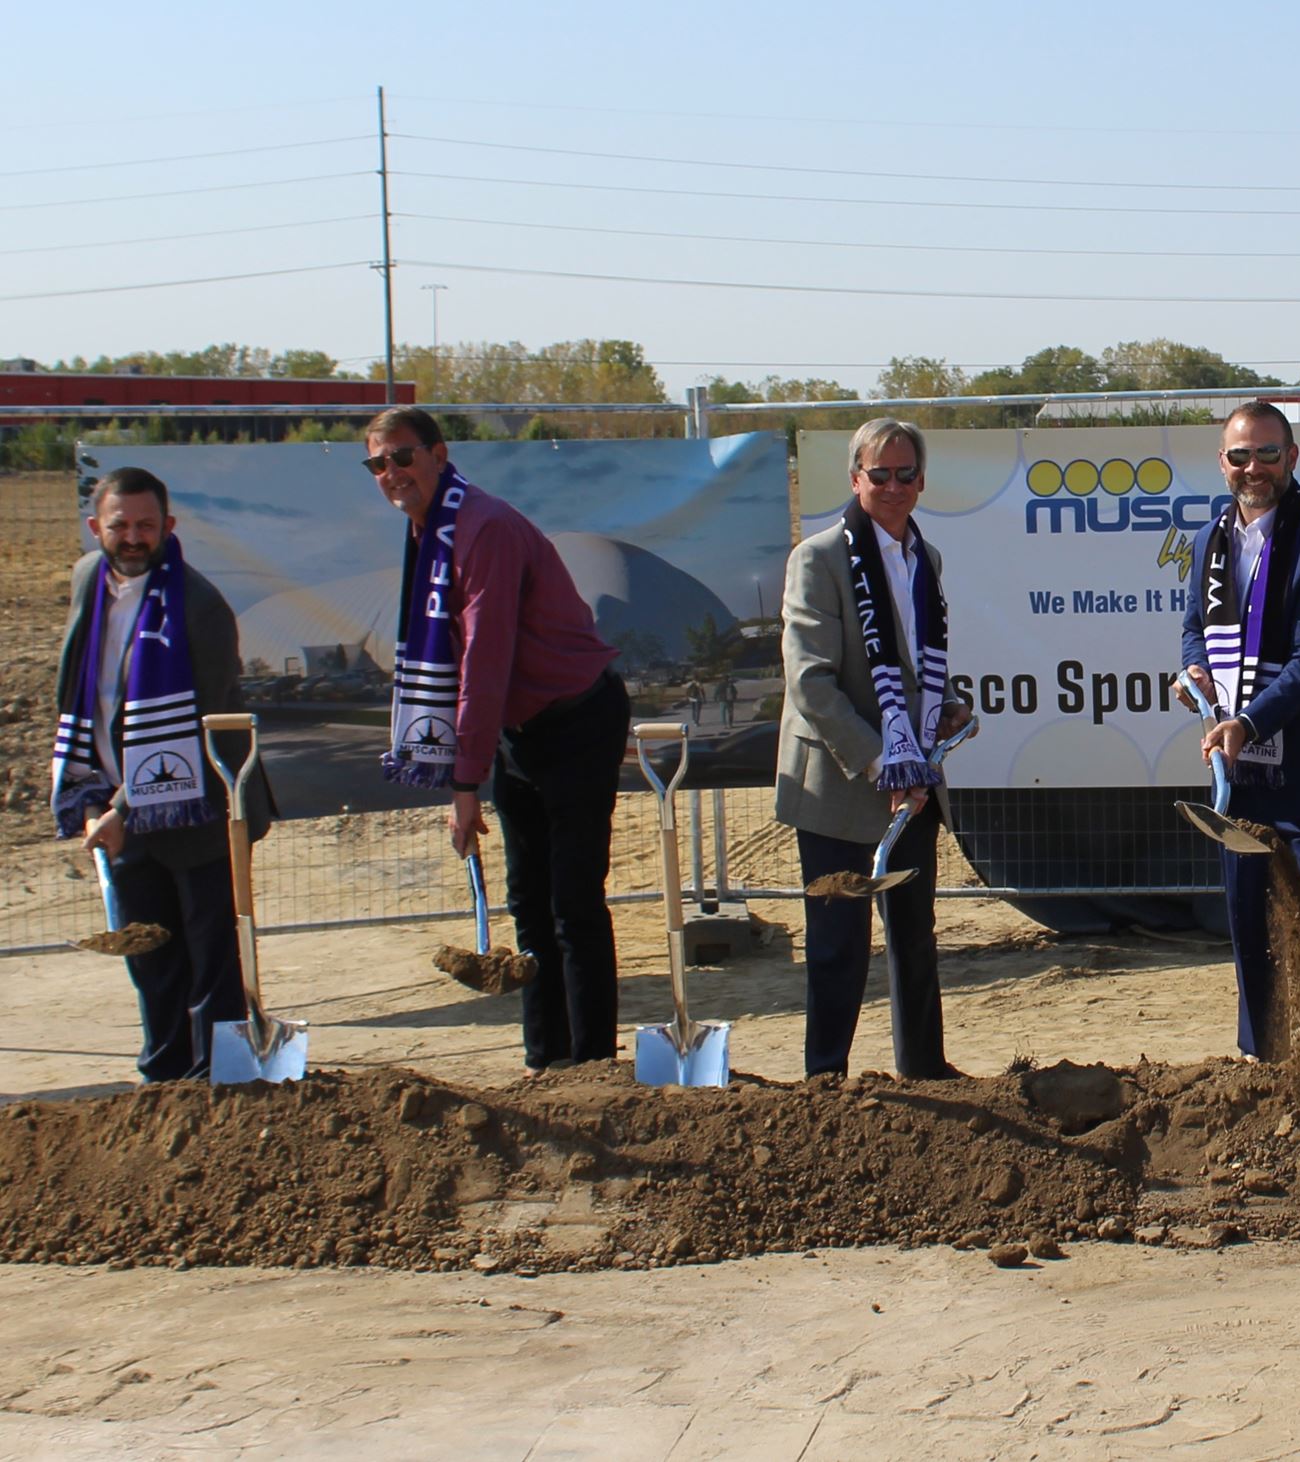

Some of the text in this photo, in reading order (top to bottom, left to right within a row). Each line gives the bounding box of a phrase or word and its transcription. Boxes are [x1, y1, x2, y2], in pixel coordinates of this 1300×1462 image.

[1029, 591, 1065, 614] We
[1073, 590, 1137, 613] Make
[1146, 589, 1163, 612] It
[1057, 660, 1178, 724] Spor
[130, 779, 198, 797] MUSCATINE
